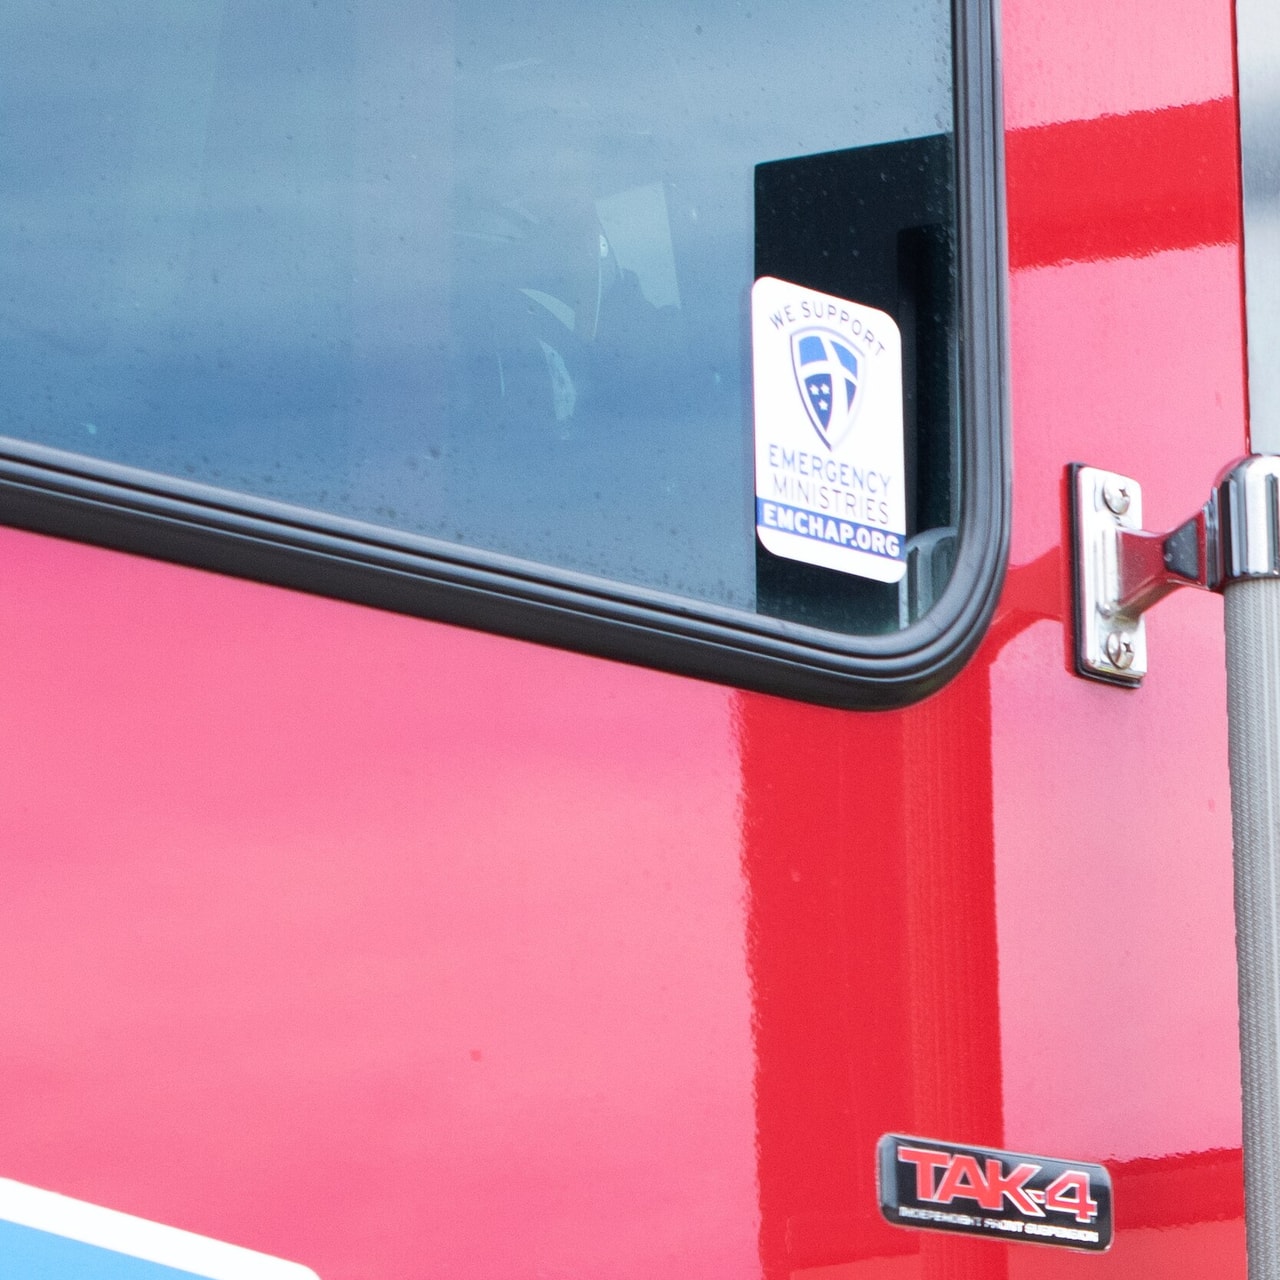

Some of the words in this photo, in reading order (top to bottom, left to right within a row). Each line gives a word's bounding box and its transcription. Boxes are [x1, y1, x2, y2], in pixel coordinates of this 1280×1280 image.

[769, 304, 796, 332] WE
[800, 301, 886, 358] SUPPORT
[768, 444, 892, 498] EMERGENCY
[771, 474, 890, 527] MINISTRIES
[763, 504, 900, 558] EMCHAP.ORG
[897, 1146, 1099, 1224] TAK-4
